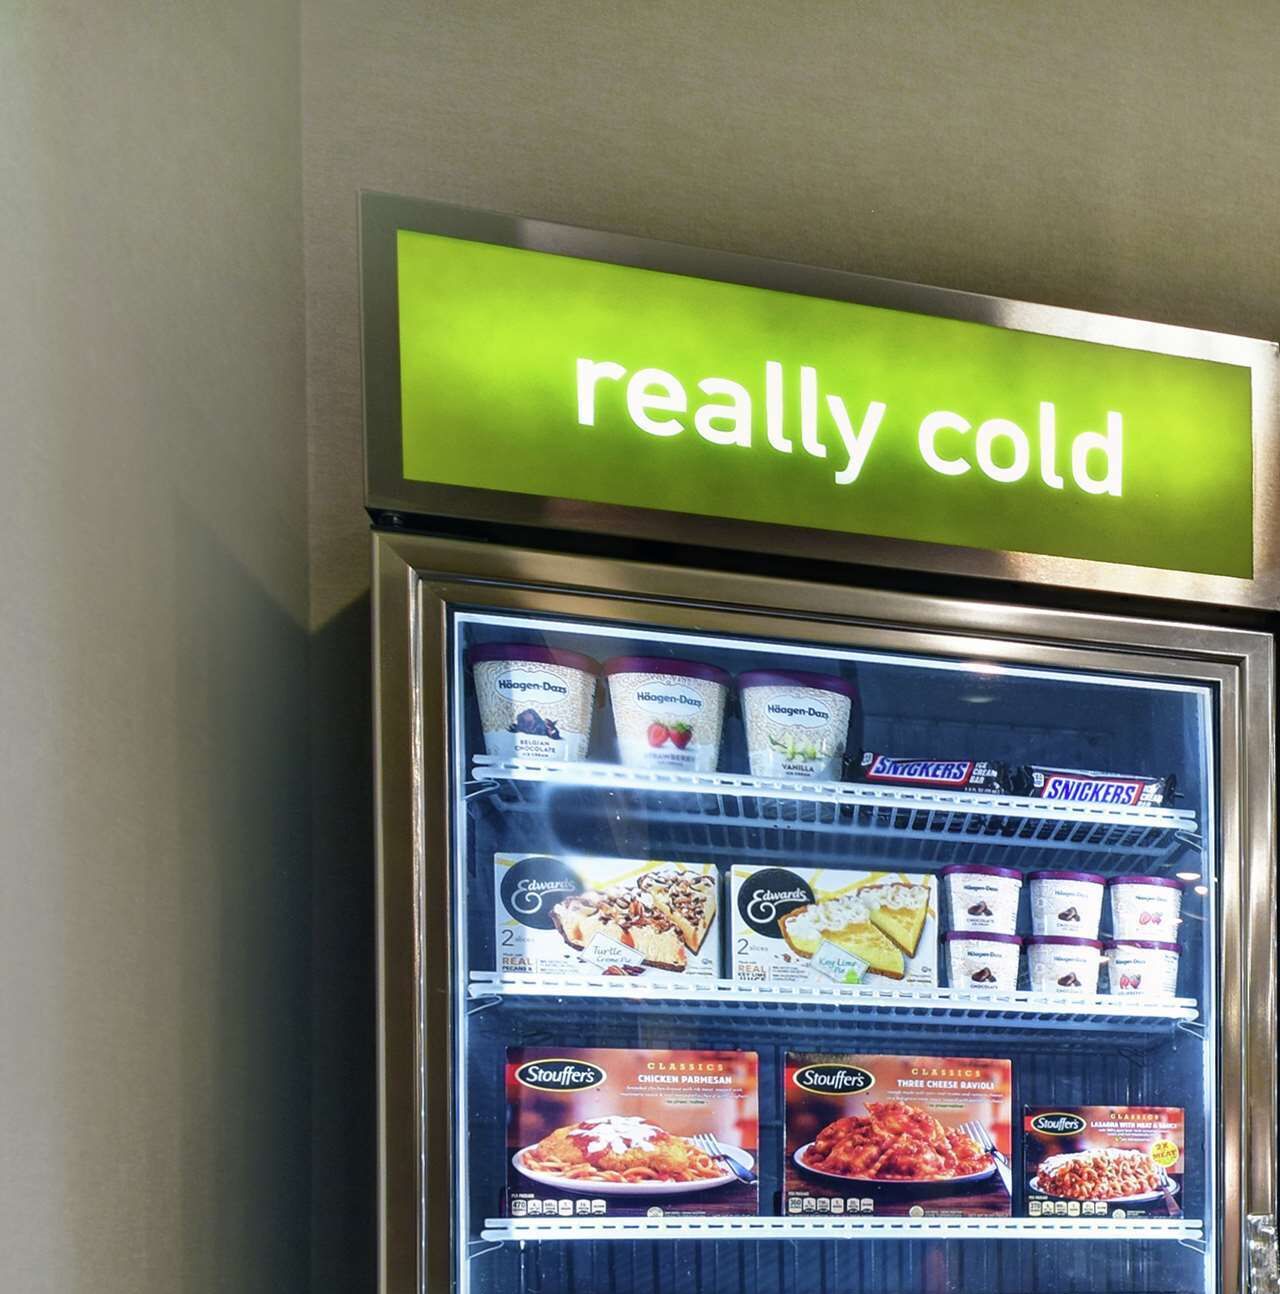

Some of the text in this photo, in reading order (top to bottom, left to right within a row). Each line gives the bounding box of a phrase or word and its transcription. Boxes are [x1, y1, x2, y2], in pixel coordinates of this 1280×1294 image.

[574, 356, 1125, 497] really cold
[782, 762, 814, 772] VANILLA
[874, 758, 971, 781] SNICKERS
[1048, 779, 1138, 805] SNICKERS
[511, 879, 576, 914] Edwards
[747, 889, 807, 923] Edwards
[501, 929, 515, 946] 2
[737, 938, 749, 955] 2
[502, 957, 533, 966] REAL
[737, 964, 767, 975] REAL
[526, 1062, 595, 1084] Stouffer's
[647, 1062, 725, 1072] CLASSICS
[912, 1067, 981, 1077] CLASSICS
[638, 1075, 732, 1085] CHICKEN PARMESAN
[803, 1068, 864, 1088] Stouffer's
[897, 1079, 995, 1090] THREE CHEESE RAVIOLI
[1037, 1116, 1079, 1131] Stouffer's
[1110, 1112, 1161, 1121] CLASSICS
[1119, 1121, 1136, 1129] WITH
